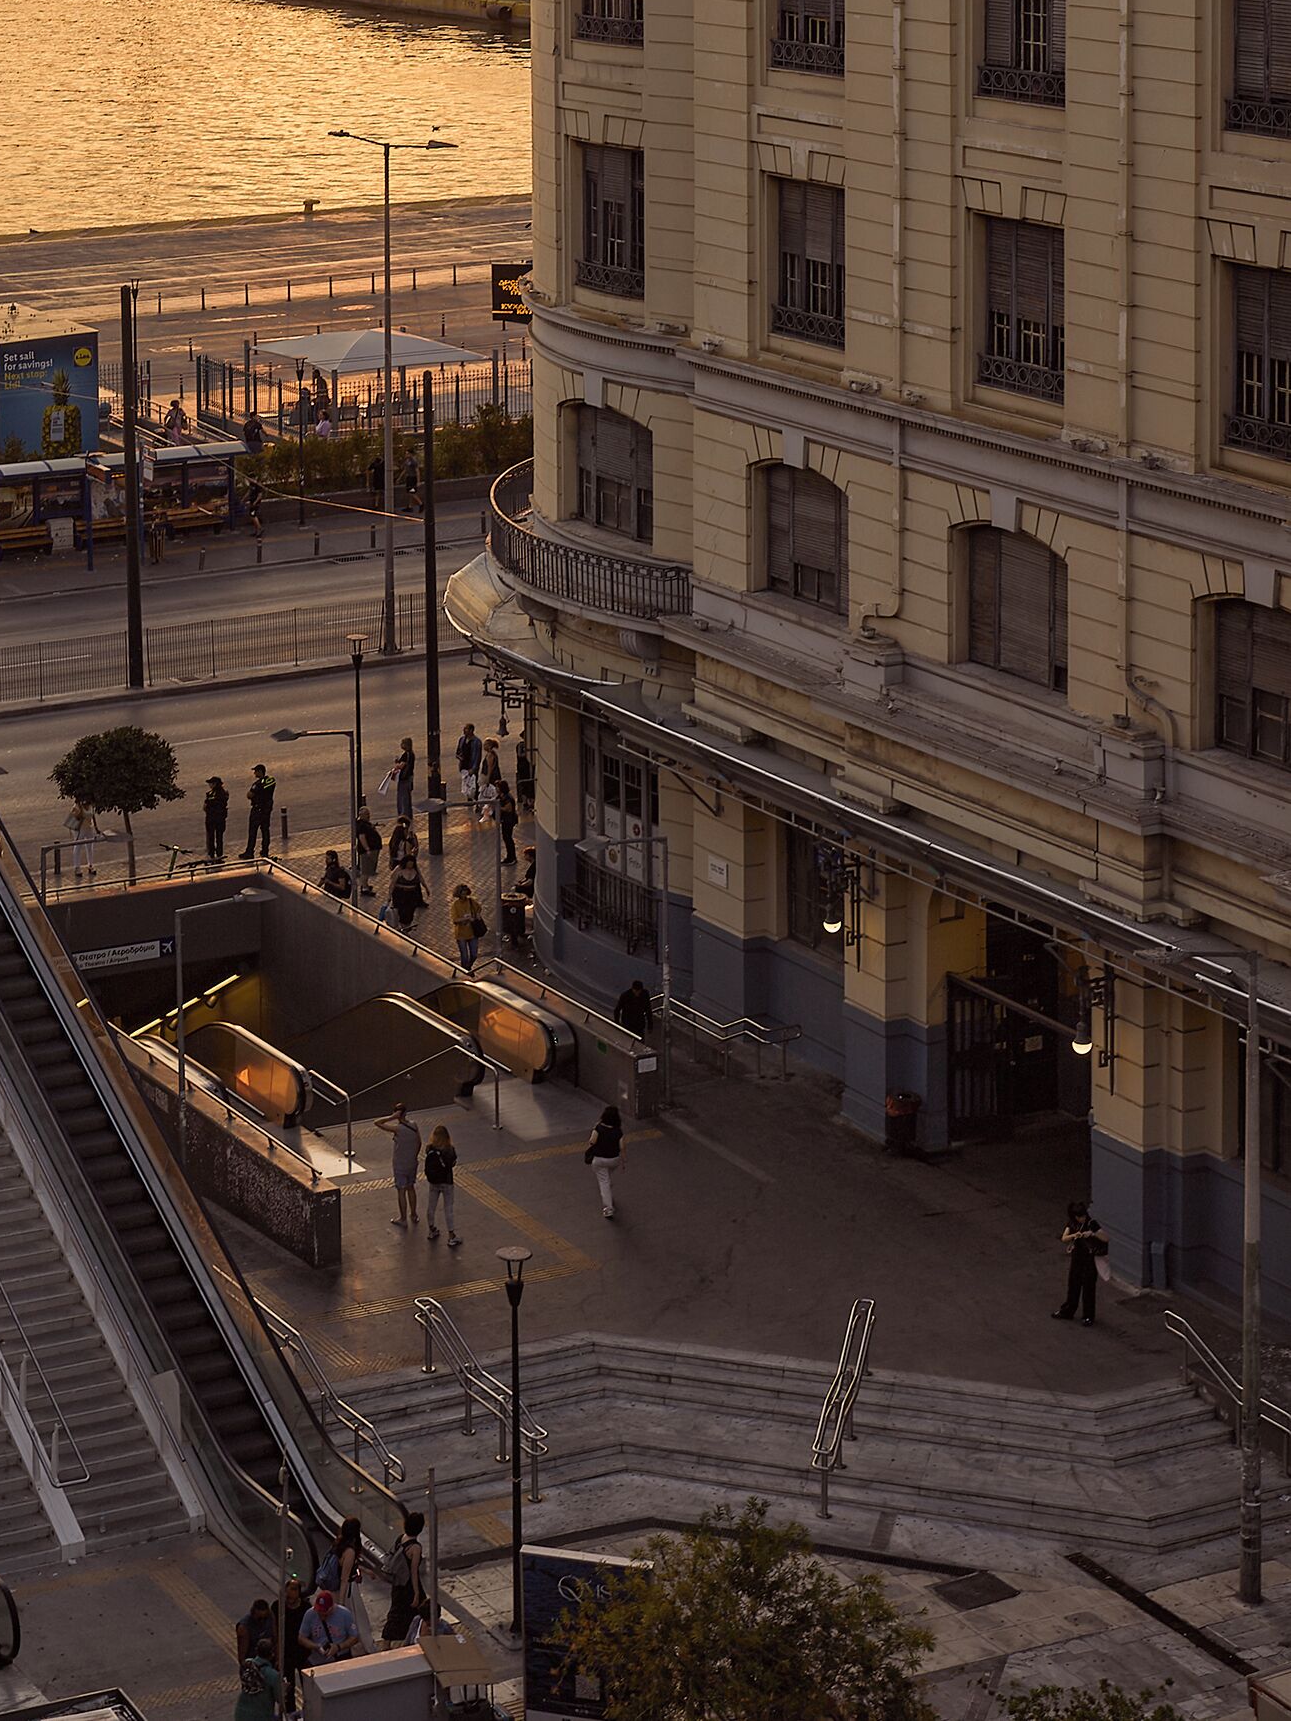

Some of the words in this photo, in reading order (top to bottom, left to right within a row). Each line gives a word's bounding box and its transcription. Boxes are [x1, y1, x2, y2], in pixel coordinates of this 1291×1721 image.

[3, 353, 18, 362] Set
[19, 351, 34, 361] sail
[4, 363, 16, 371] for
[18, 359, 53, 370] savings!
[4, 371, 25, 380] Next
[112, 944, 155, 957] Αεροδρόμιο
